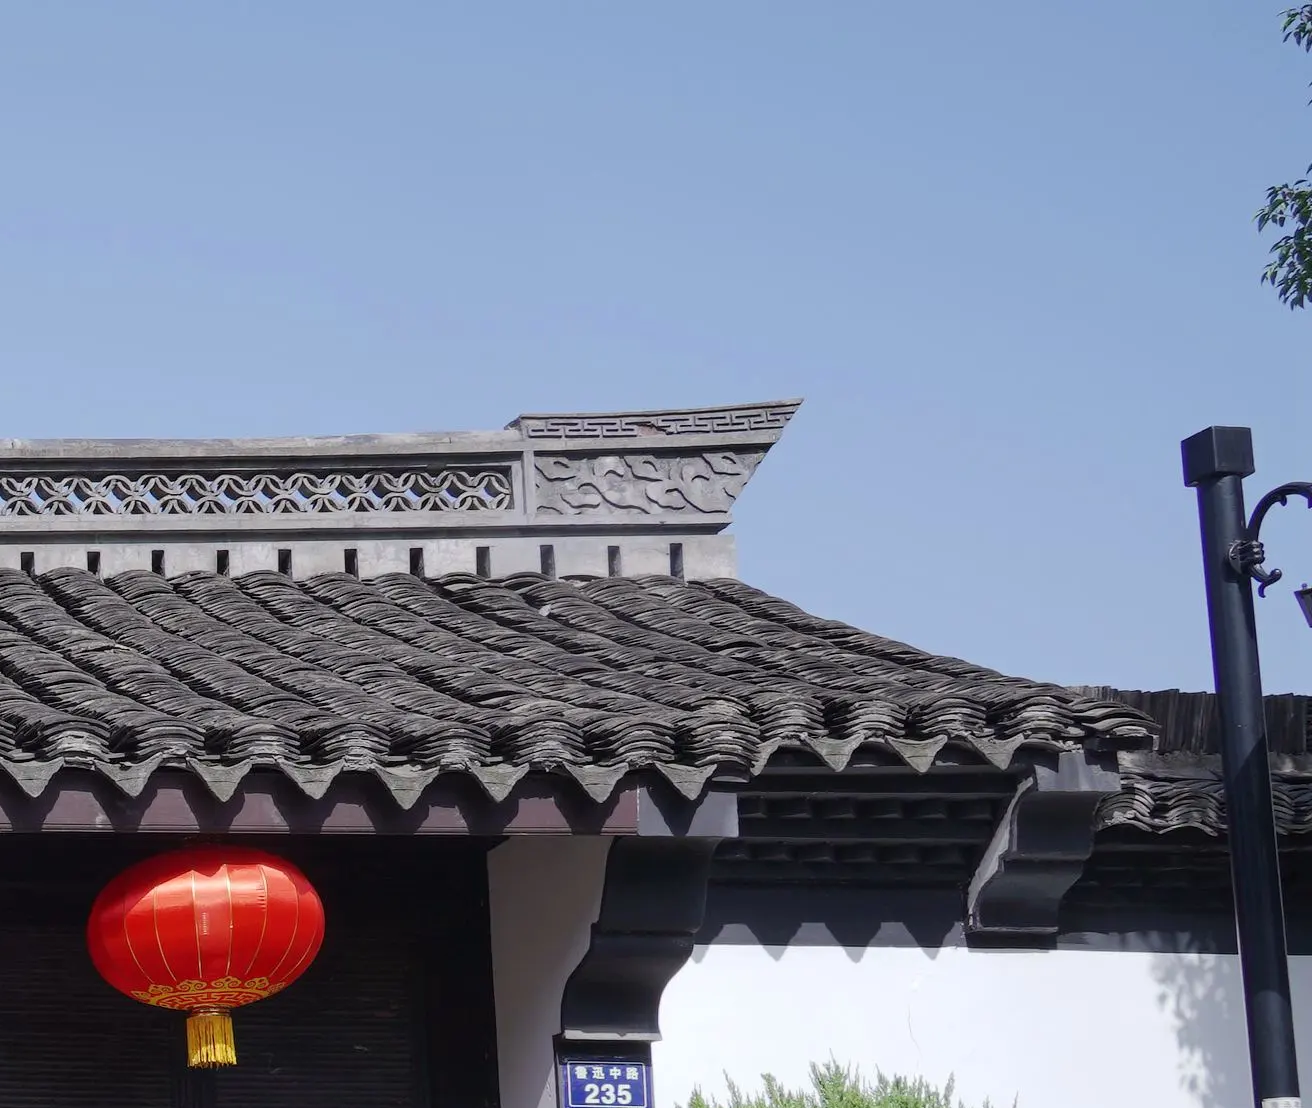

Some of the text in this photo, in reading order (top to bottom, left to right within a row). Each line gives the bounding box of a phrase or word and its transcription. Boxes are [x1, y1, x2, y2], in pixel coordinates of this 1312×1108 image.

[575, 1066, 639, 1080] 鲁迅中路
[584, 1083, 632, 1105] 235
